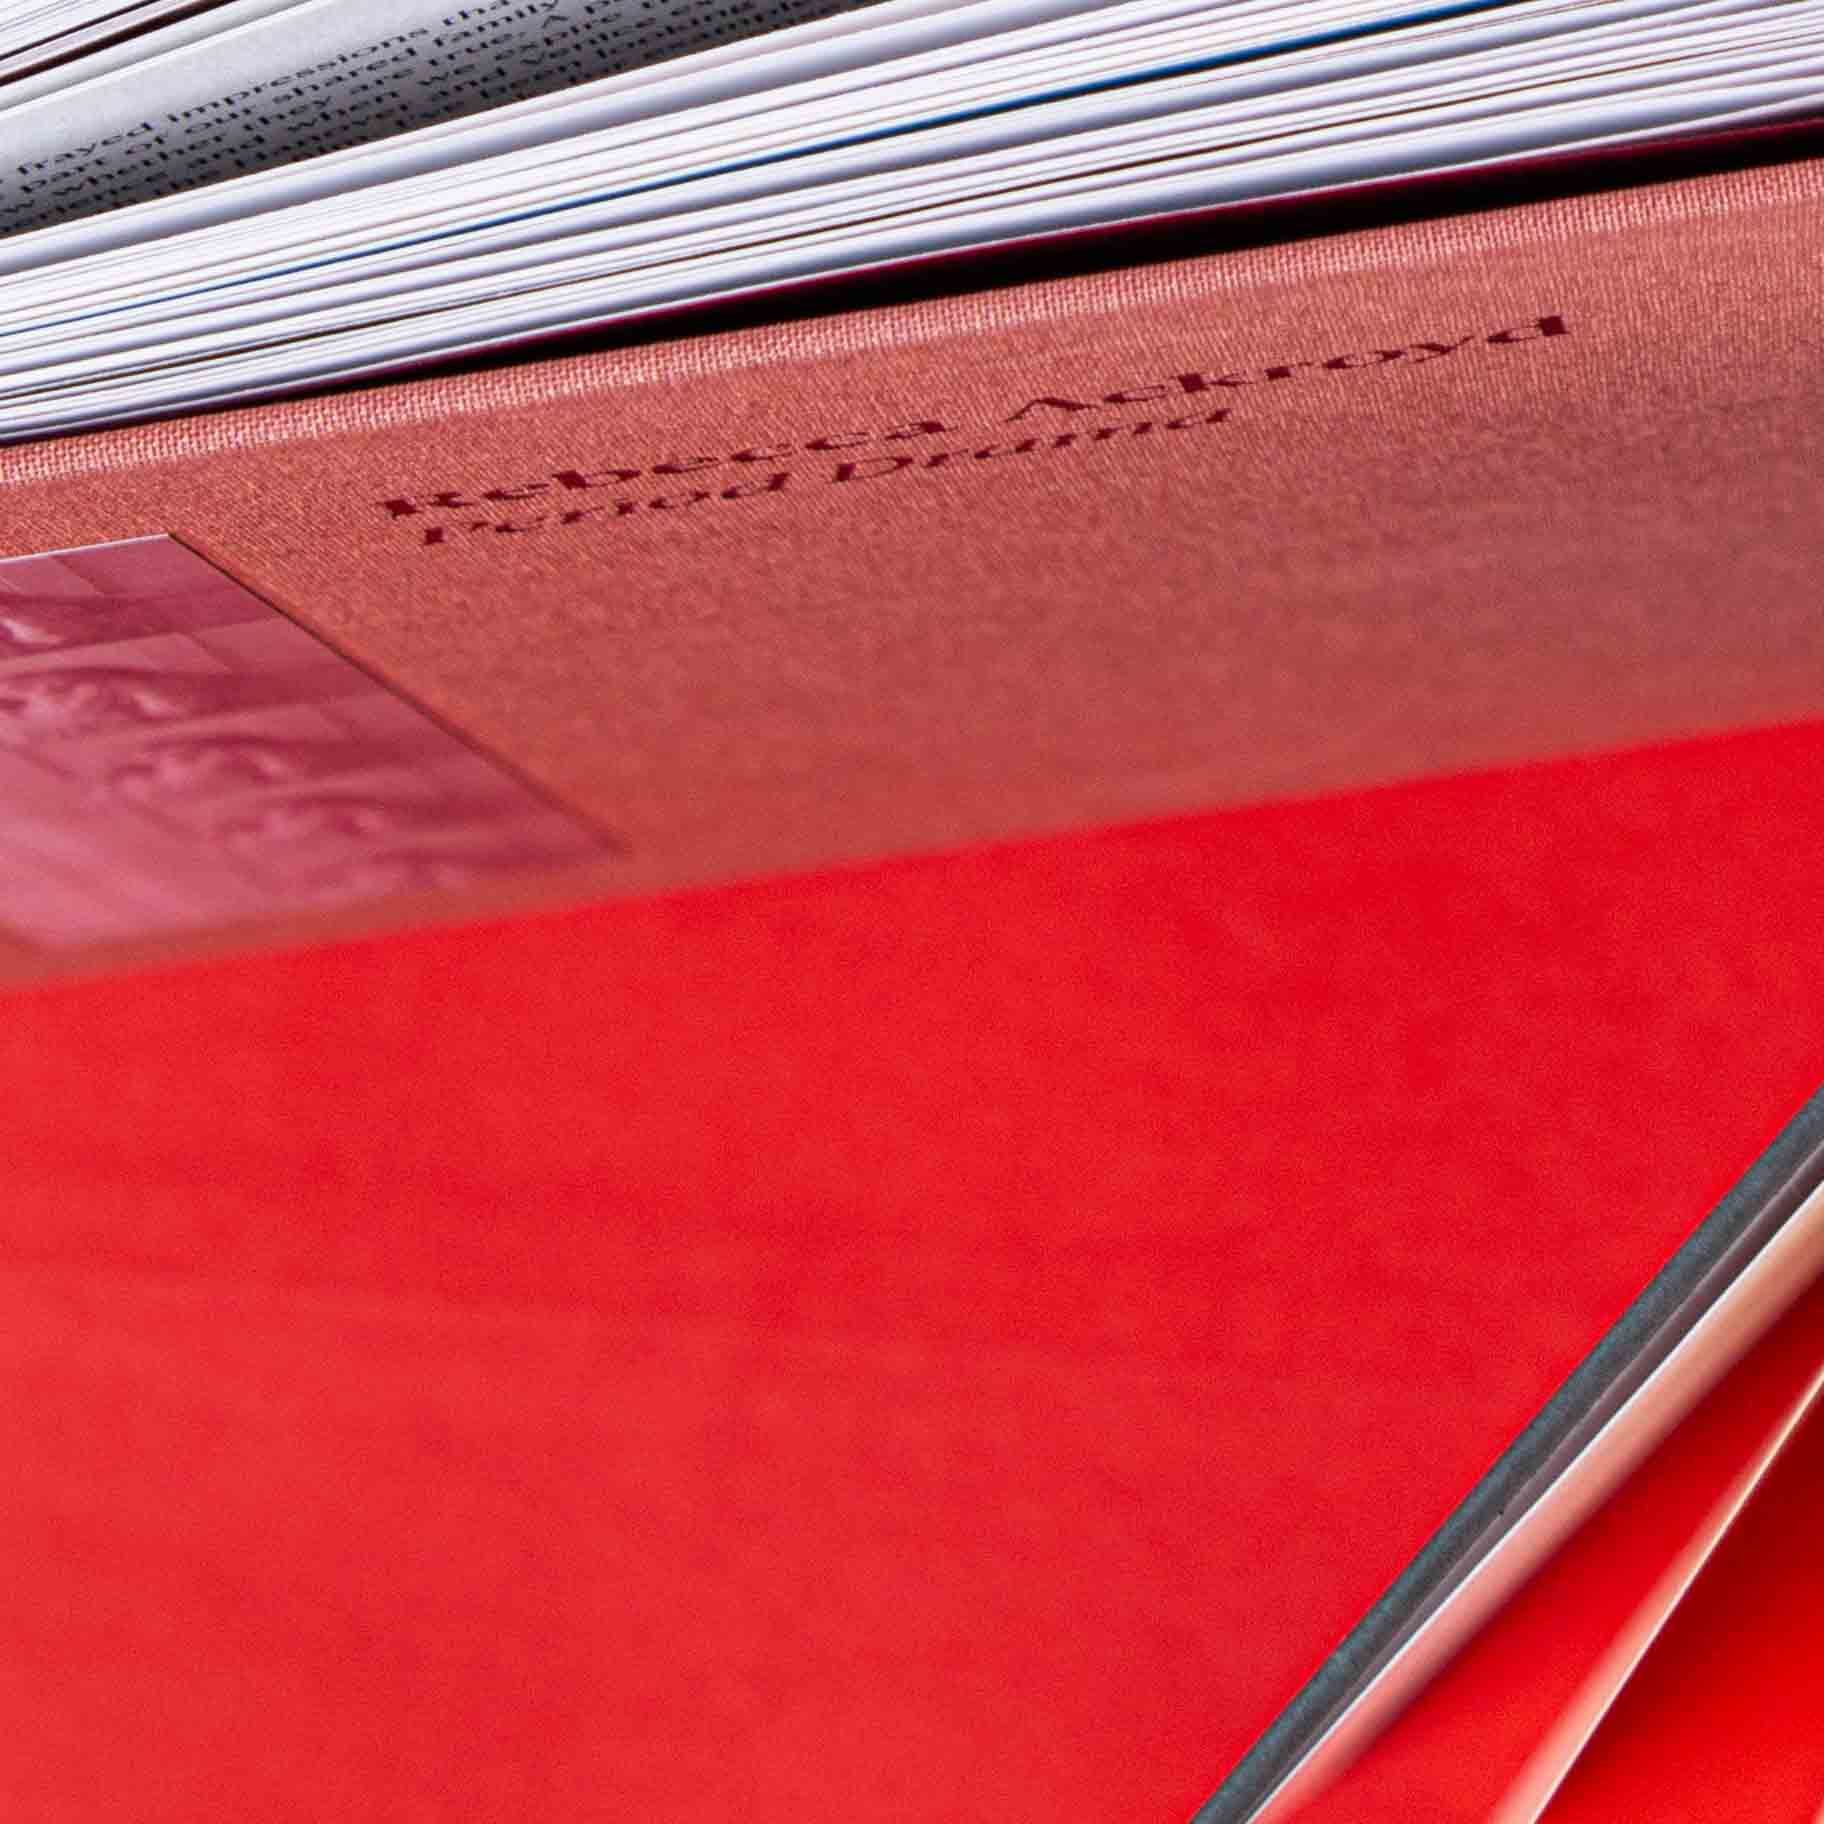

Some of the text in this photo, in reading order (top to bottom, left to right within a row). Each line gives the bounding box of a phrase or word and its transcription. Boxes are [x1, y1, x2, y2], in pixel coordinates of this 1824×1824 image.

[15, 121, 156, 178] frayed
[166, 27, 431, 125] impressions
[17, 156, 110, 199] part
[123, 132, 169, 158] of
[183, 103, 260, 138] our
[271, 46, 420, 108] shared
[50, 132, 227, 199] whether
[241, 94, 334, 133] they
[348, 67, 417, 97] are
[185, 133, 268, 175] and
[284, 90, 402, 139] when
[415, 62, 479, 89] we
[492, 11, 625, 63] expire
[377, 314, 1569, 520] Rebecca Ackroyd
[424, 407, 1232, 547] Period Drama
